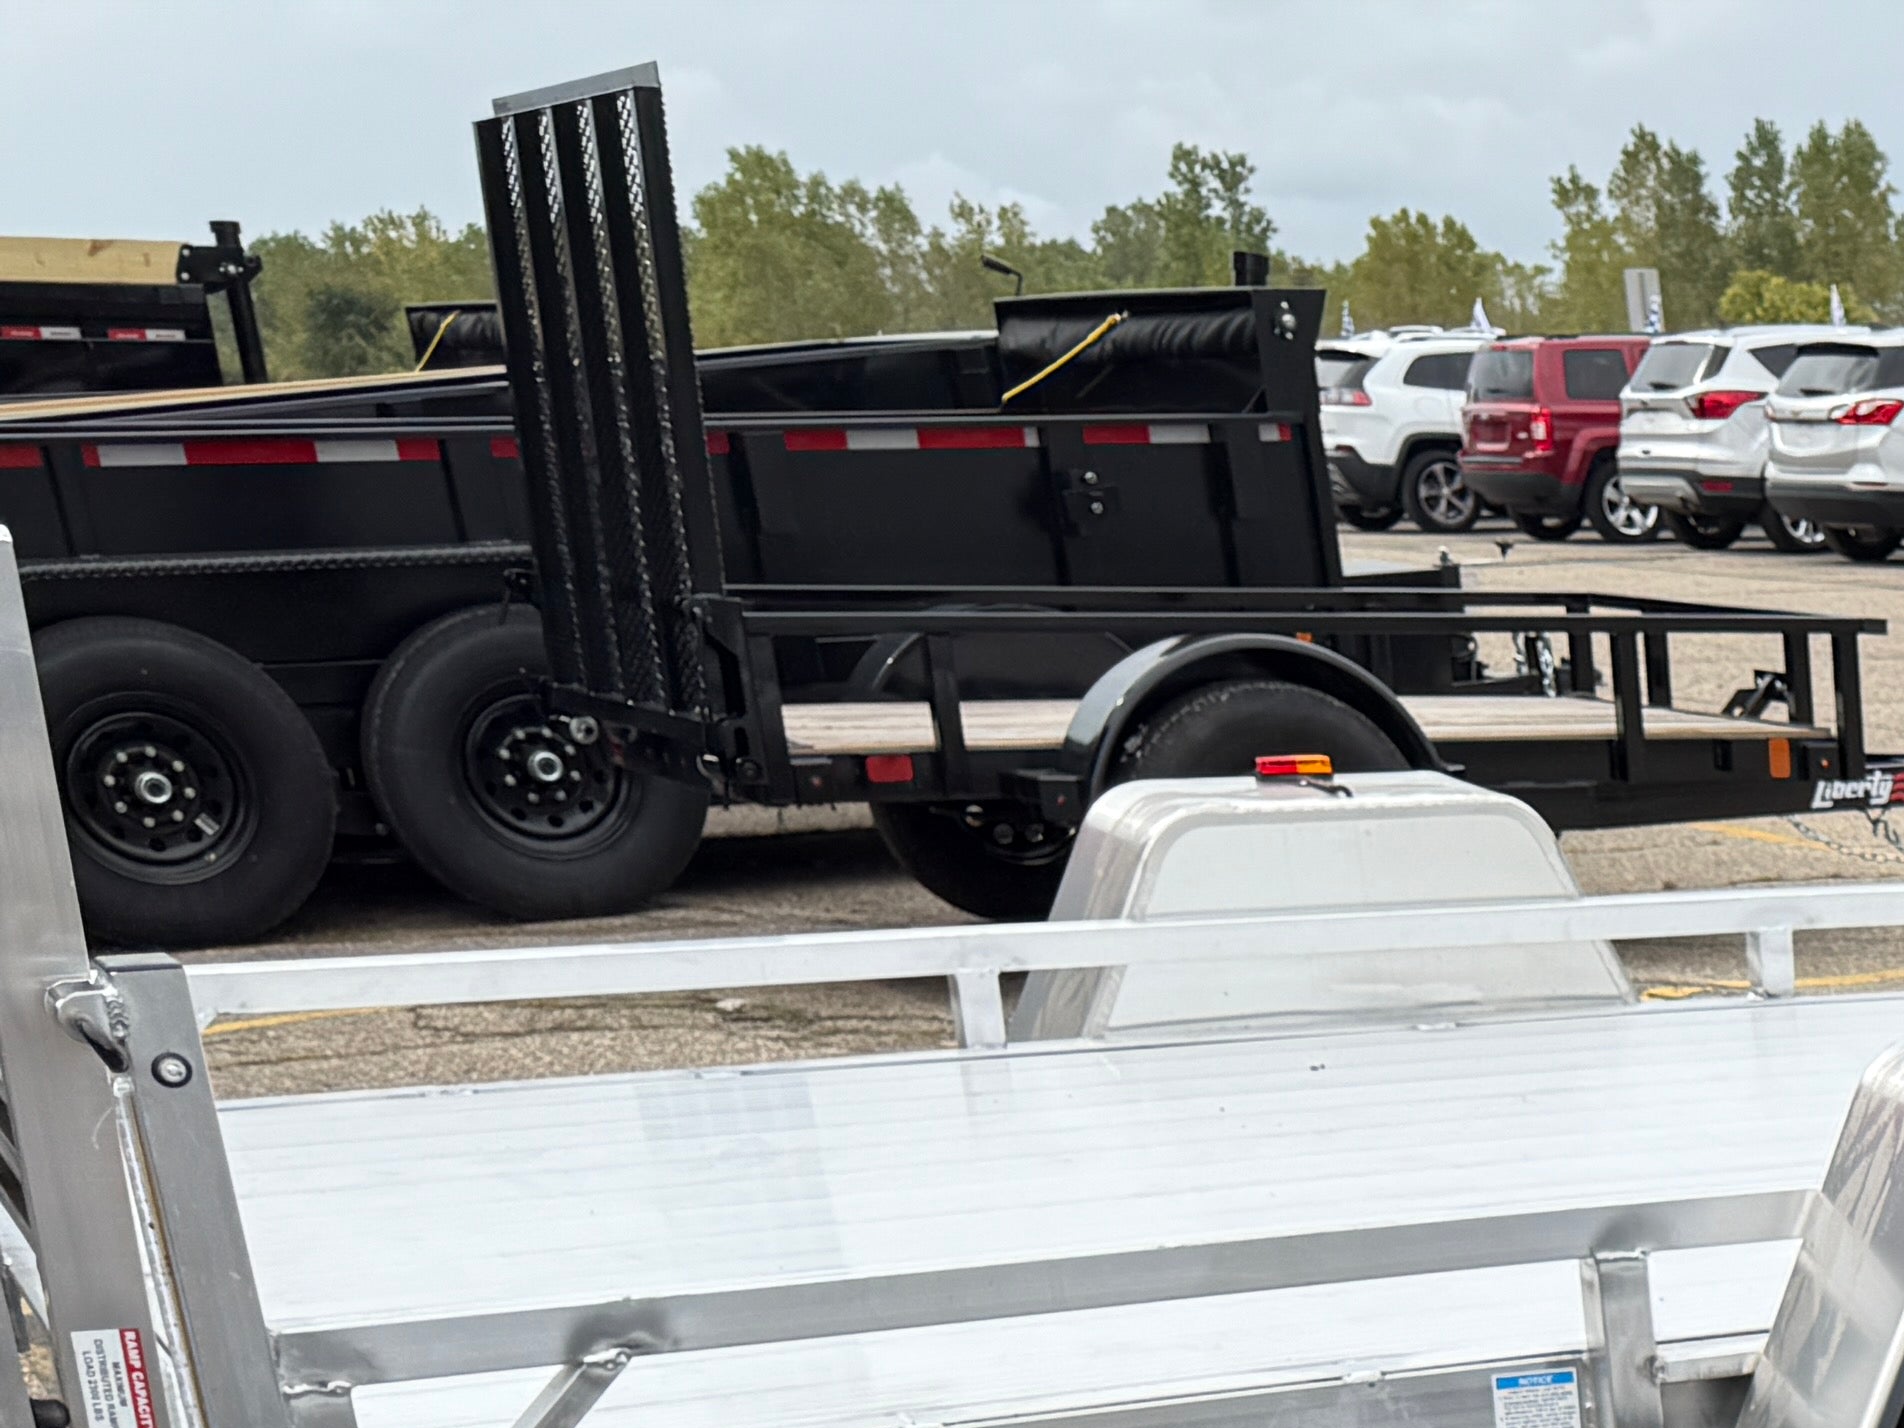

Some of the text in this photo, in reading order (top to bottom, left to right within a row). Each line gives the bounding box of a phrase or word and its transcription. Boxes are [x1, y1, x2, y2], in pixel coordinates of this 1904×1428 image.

[1811, 769, 1894, 809] Liberty
[82, 1350, 96, 1378] LOAD
[124, 1330, 142, 1369] RAMP
[93, 1338, 114, 1402] DISTRIBUTED
